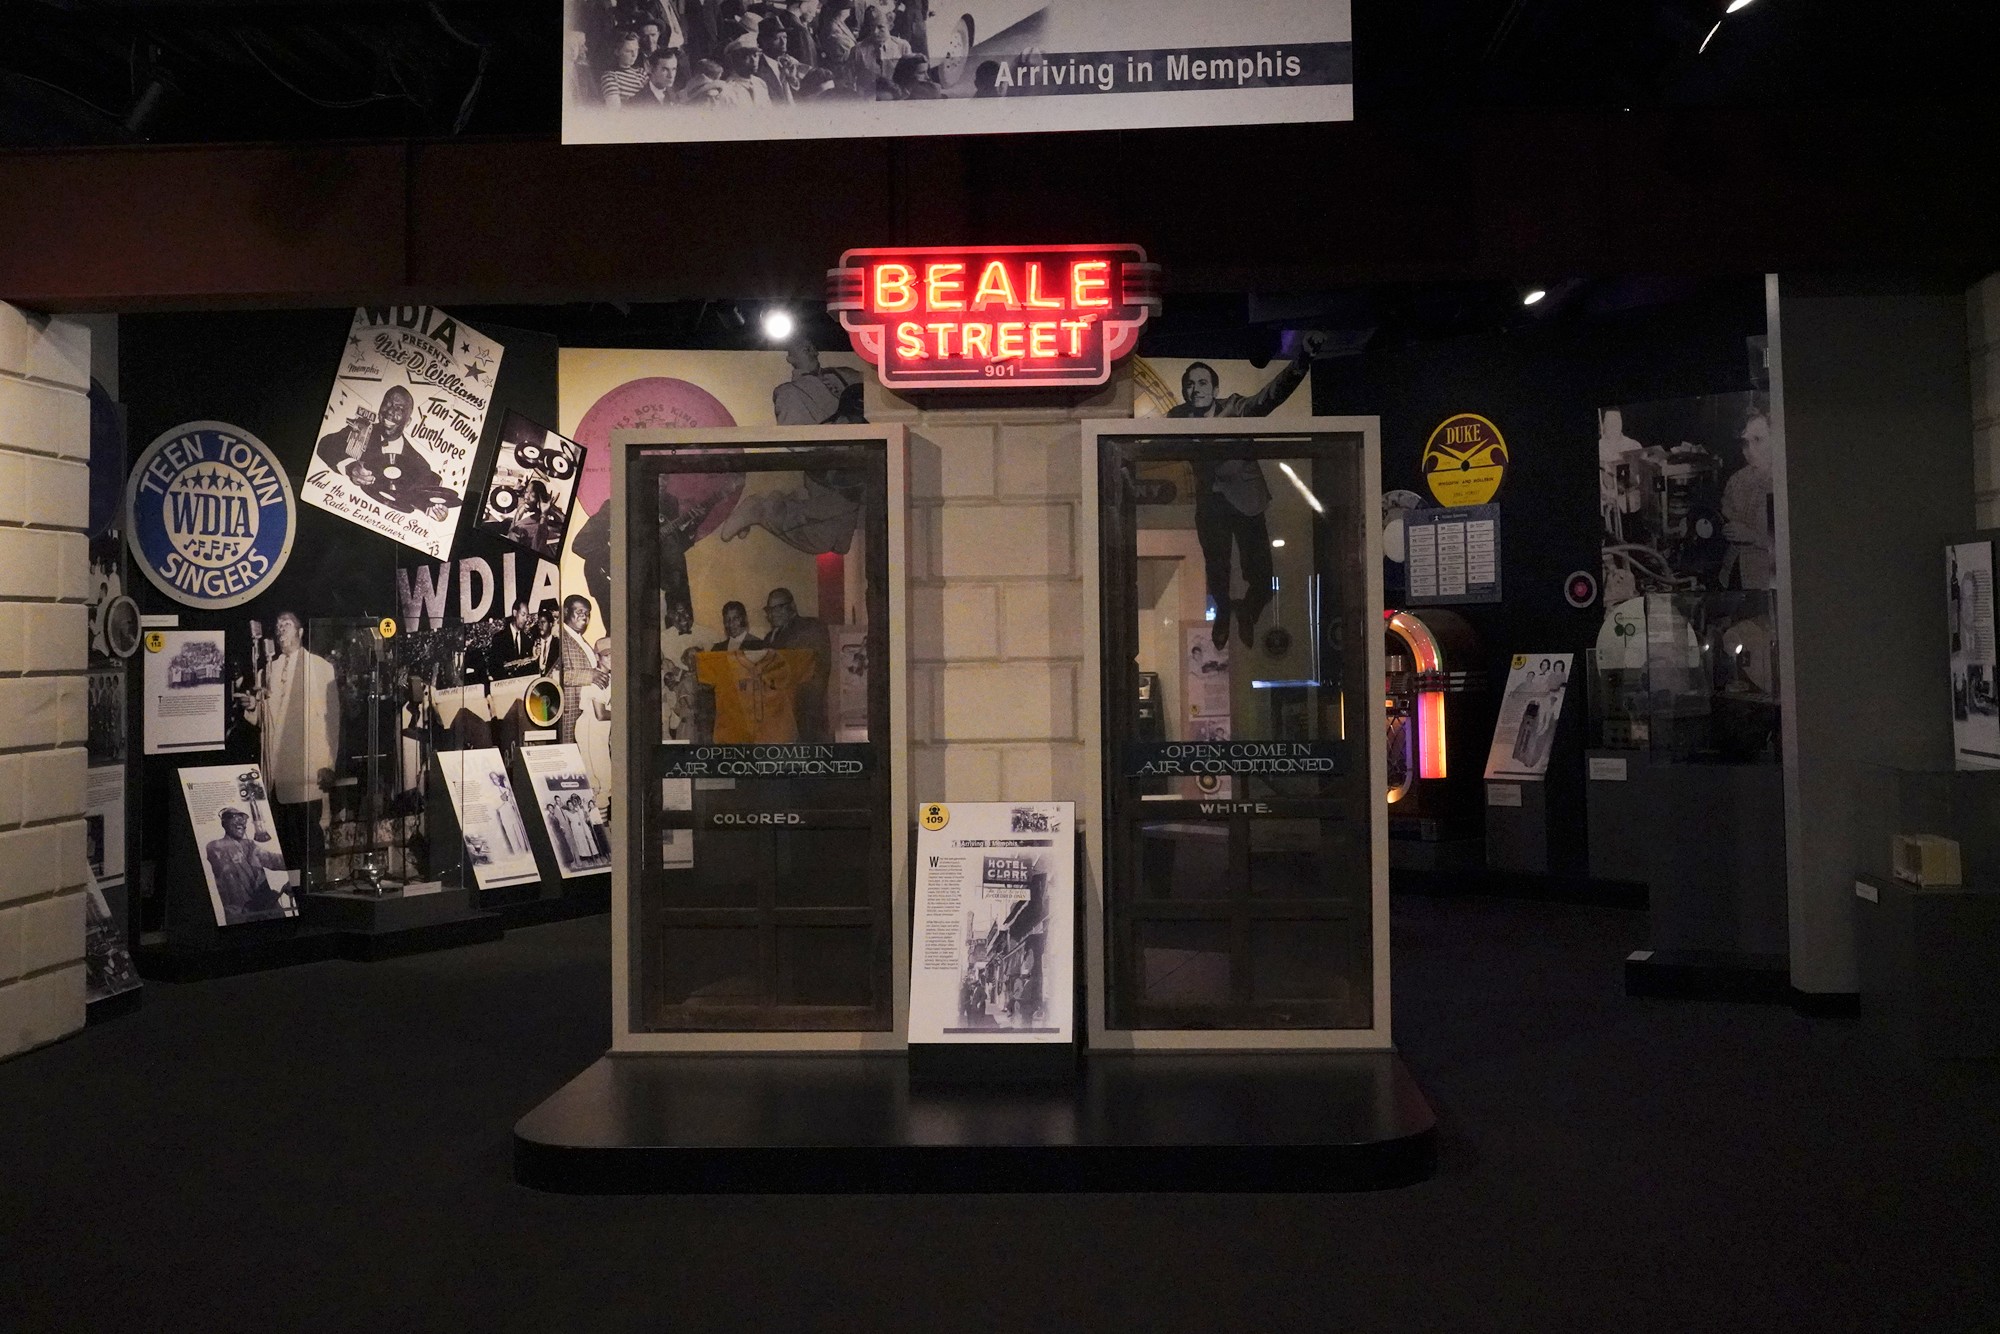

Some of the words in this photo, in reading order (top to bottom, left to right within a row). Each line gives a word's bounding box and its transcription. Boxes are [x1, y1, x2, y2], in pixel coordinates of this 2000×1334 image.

[994, 58, 1114, 91] Arriving
[1127, 56, 1152, 83] in
[1167, 51, 1301, 85] Memphis
[873, 259, 1113, 314] BEALE
[362, 305, 458, 356] WDIA
[896, 321, 1093, 362] STREET
[375, 332, 407, 364] Nat
[408, 351, 425, 375] D.
[402, 333, 451, 368] PRESENTS
[348, 363, 380, 376] Memphis
[984, 364, 1015, 377] 901
[428, 397, 479, 445] Tan-Town
[634, 403, 665, 417] BOYS
[670, 406, 698, 428] KING
[411, 415, 467, 461] Jamboree
[1445, 423, 1481, 445] DUKE
[140, 434, 205, 496] TEEN
[217, 434, 284, 508] TOWN
[169, 490, 254, 539] WDIA
[306, 469, 330, 491] And
[331, 485, 345, 499] the
[349, 493, 381, 516] WDIA
[384, 510, 402, 526] All
[403, 519, 430, 539] Star
[322, 494, 350, 514] Radio
[352, 509, 406, 541] Entertainers
[428, 544, 440, 556] 73
[159, 548, 269, 597] SINGERS
[396, 551, 561, 634] WDIA
[696, 747, 746, 760] OPEN
[752, 746, 811, 760] COME
[815, 746, 834, 758] IN
[1140, 760, 1184, 774] AIR
[1189, 758, 1334, 774] CONDITIONED
[1166, 744, 1222, 759] OPEN
[1230, 743, 1287, 757] COME
[1293, 743, 1311, 755] IN
[672, 761, 707, 775] AIR
[717, 760, 863, 775] CONDITIONED
[713, 813, 806, 825] COLORED.
[926, 816, 943, 824] 109
[1200, 803, 1272, 814] WHITE.
[987, 869, 1028, 880] CLARK
[988, 859, 1028, 870] HOTEL
